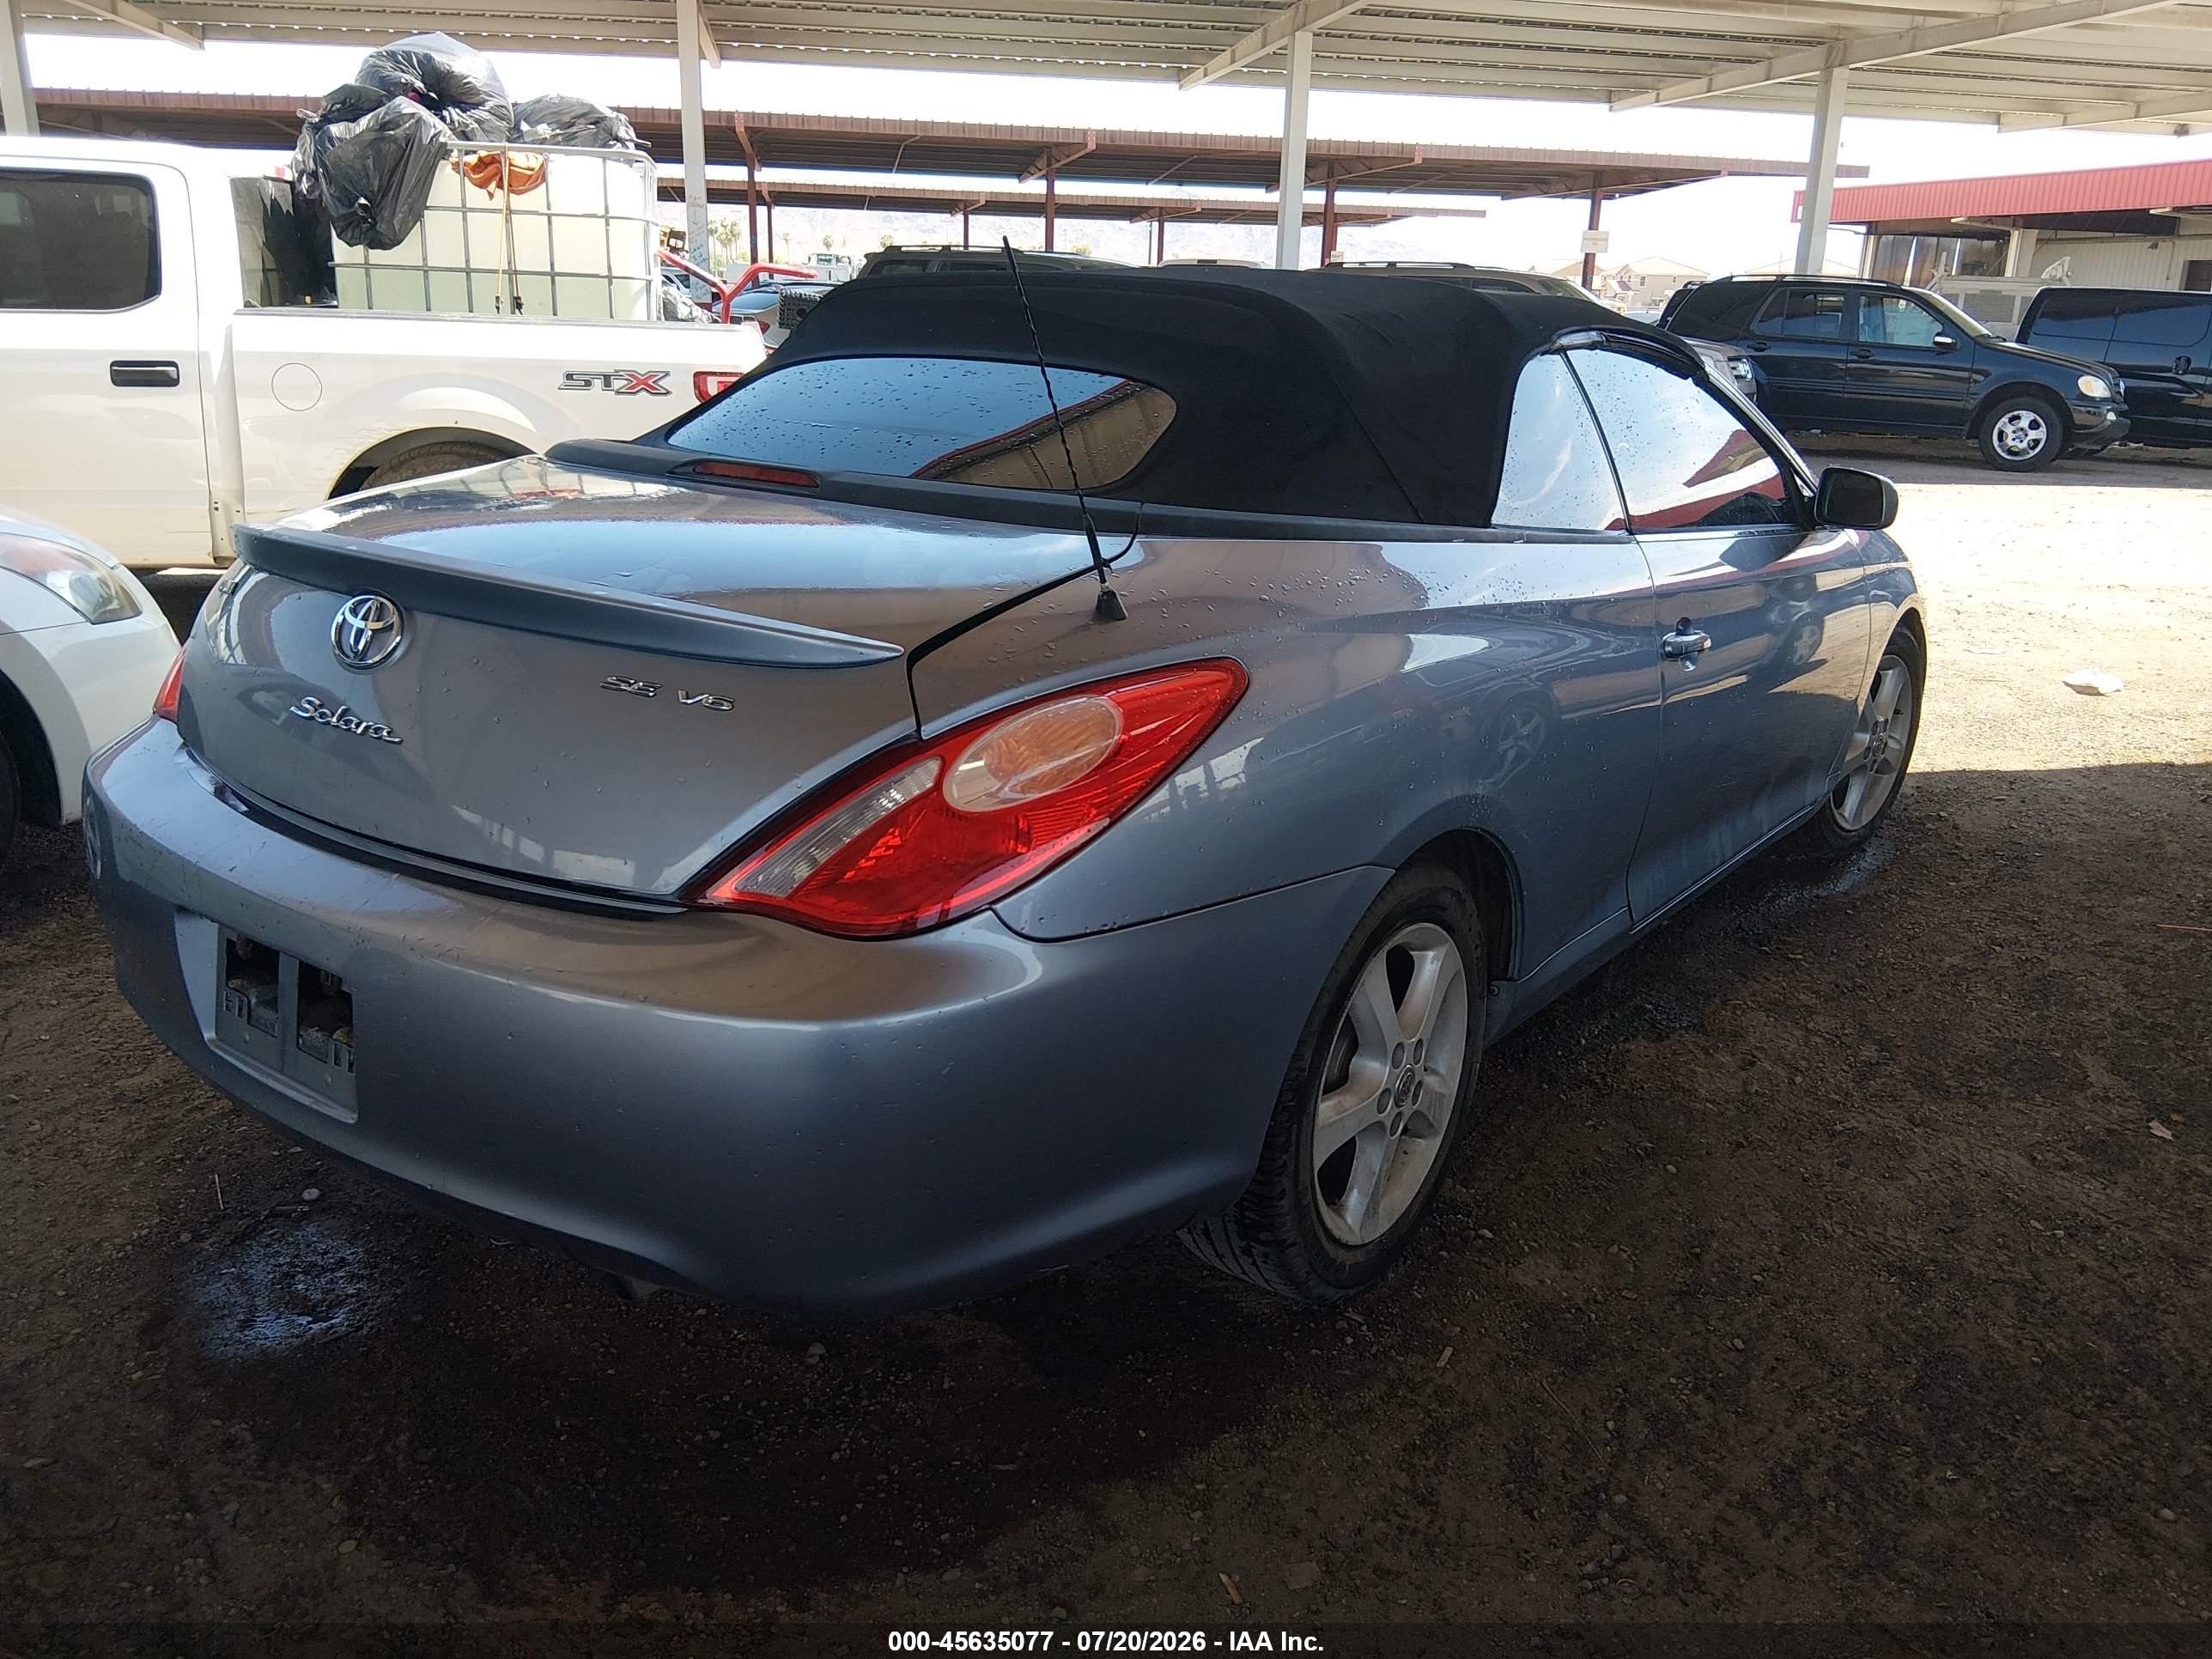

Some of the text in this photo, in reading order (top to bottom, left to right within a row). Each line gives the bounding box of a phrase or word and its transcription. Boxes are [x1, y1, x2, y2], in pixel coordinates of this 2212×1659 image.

[558, 369, 672, 397] STX
[599, 676, 735, 710] SE V6
[289, 696, 404, 744] Solara
